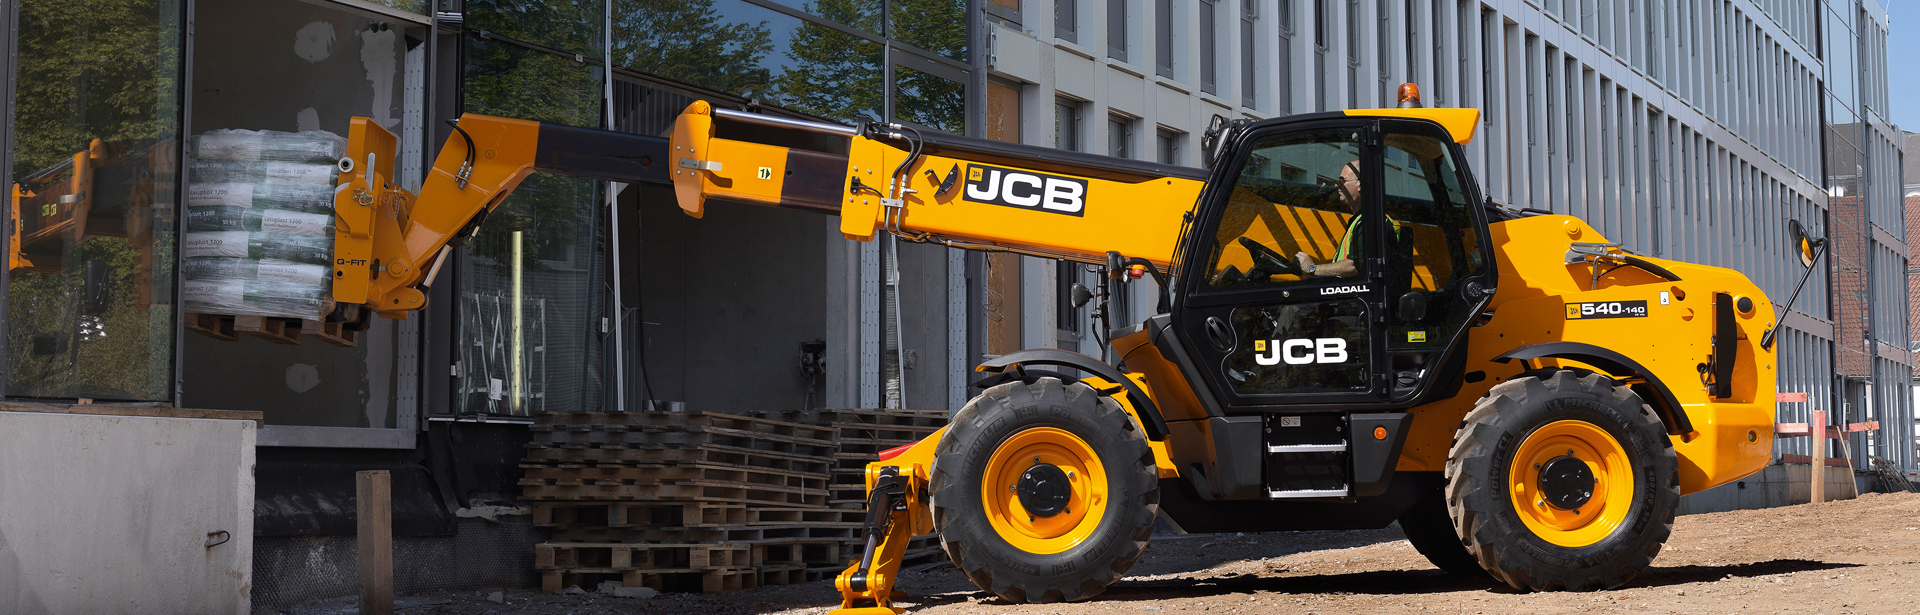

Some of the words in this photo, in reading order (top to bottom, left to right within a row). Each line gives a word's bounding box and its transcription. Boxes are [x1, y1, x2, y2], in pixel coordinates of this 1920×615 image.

[967, 170, 1083, 213] JCB
[337, 258, 366, 266] Q-FIT
[1320, 285, 1370, 295] LOADALL
[1581, 302, 1645, 315] 540-140
[1255, 338, 1348, 365] JCB
[963, 416, 1006, 474] MICHELIN
